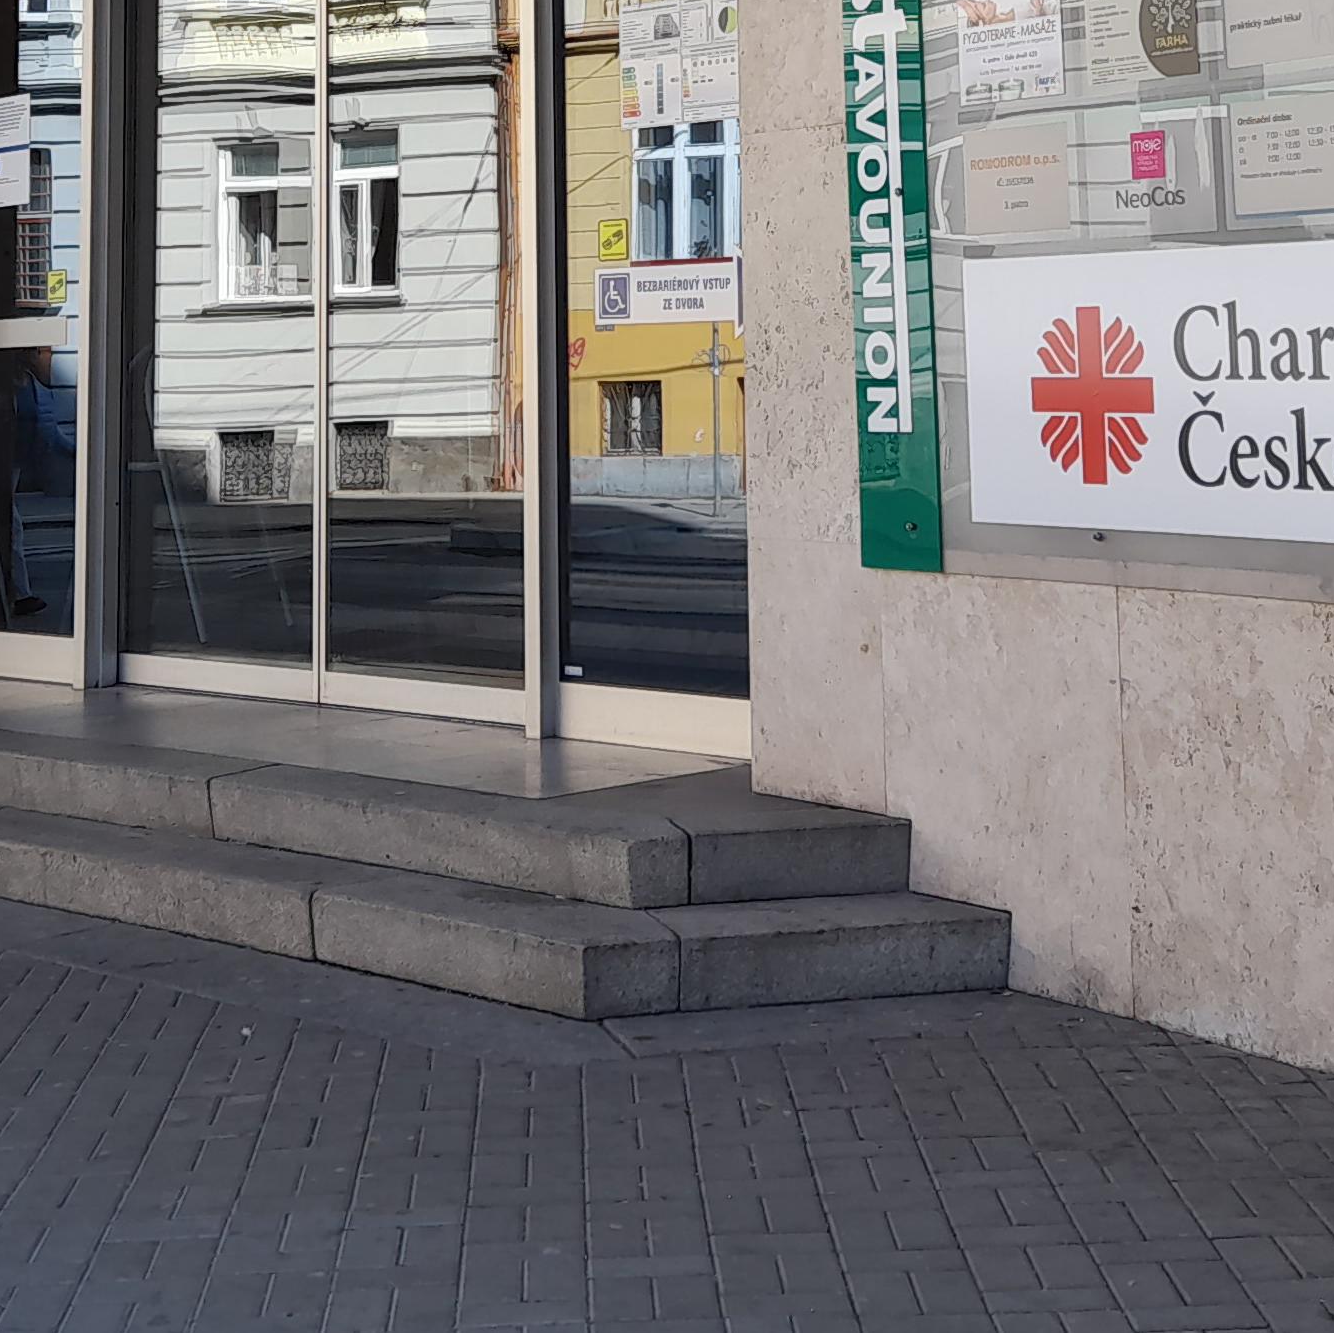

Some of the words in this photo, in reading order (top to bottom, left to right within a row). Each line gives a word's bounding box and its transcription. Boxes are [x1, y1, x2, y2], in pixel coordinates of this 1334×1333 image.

[1155, 33, 1189, 50] FARHA
[1116, 185, 1186, 210] NeoCos
[636, 275, 700, 293] BEZBARIÉROVÝ
[702, 277, 731, 291] VSTUP
[662, 298, 674, 311] ZE
[675, 296, 705, 310] DVORA
